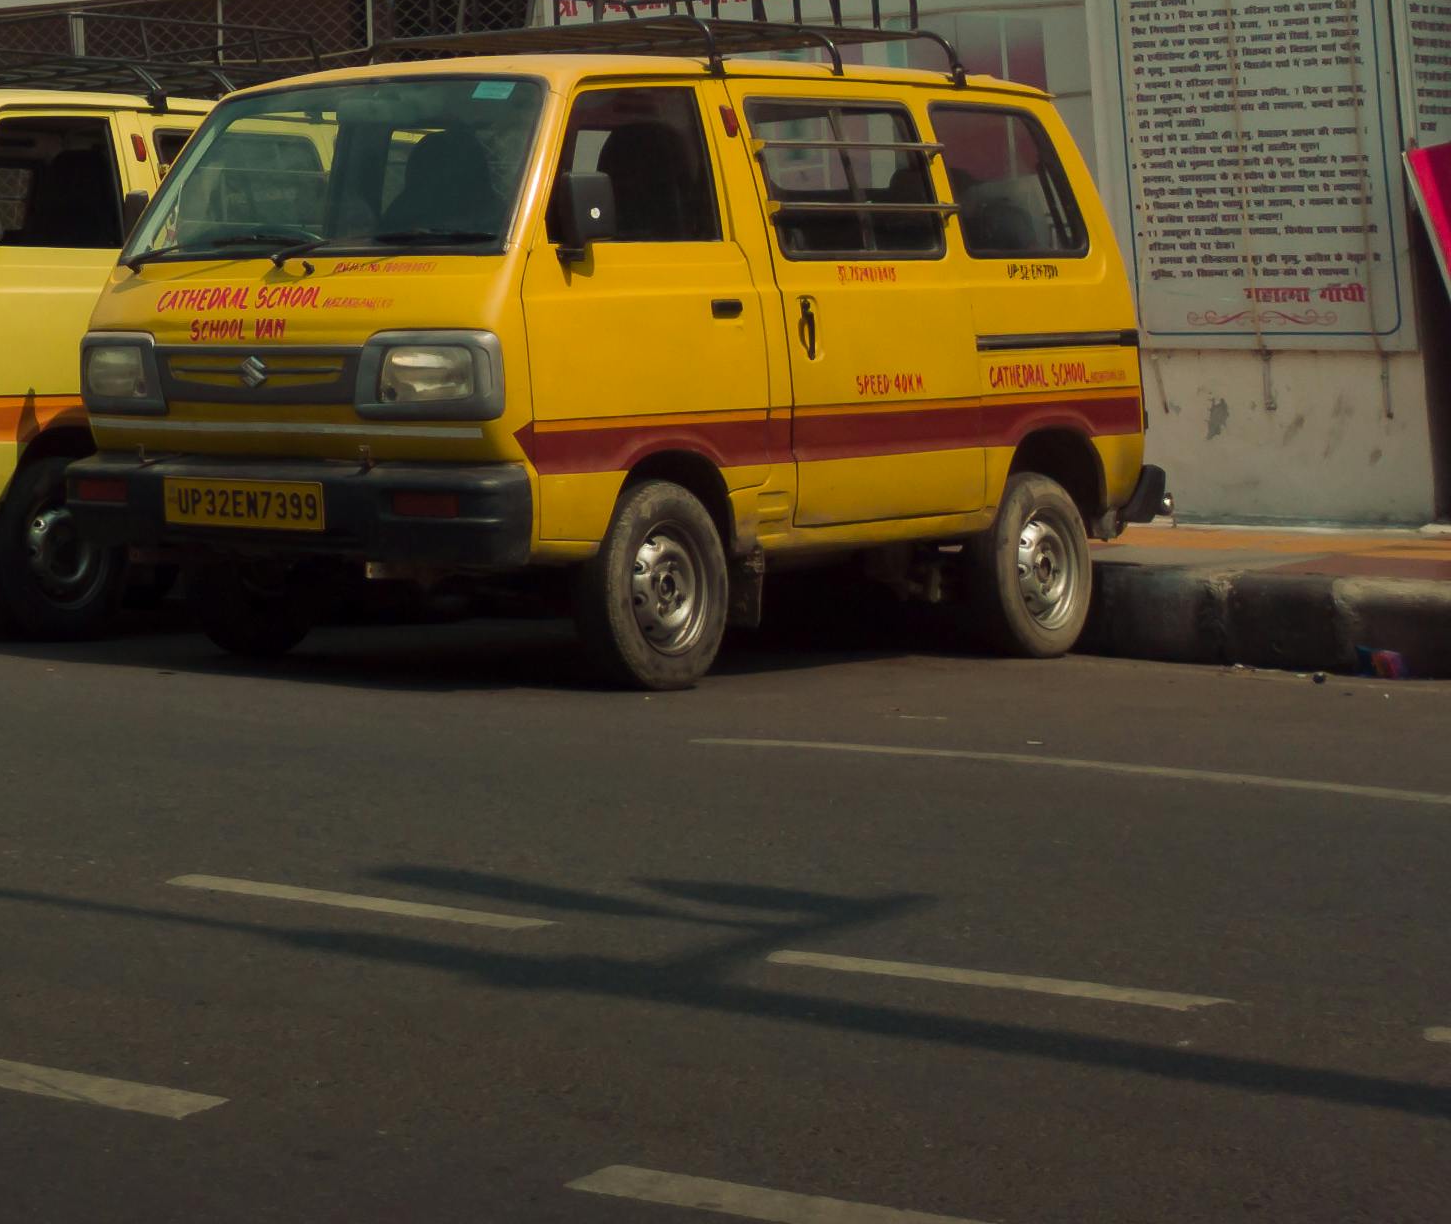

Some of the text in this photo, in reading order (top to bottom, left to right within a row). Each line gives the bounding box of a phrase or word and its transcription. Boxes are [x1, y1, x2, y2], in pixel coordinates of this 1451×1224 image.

[157, 287, 249, 313] CATHEDRAL
[254, 285, 321, 310] SCHOOL
[190, 318, 287, 342] SCHOOL VAN
[856, 374, 890, 396] SPEED
[989, 362, 1049, 389] CATHEDRAL
[1051, 361, 1090, 386] SCHOOL
[178, 487, 318, 522] UP32EN7399
